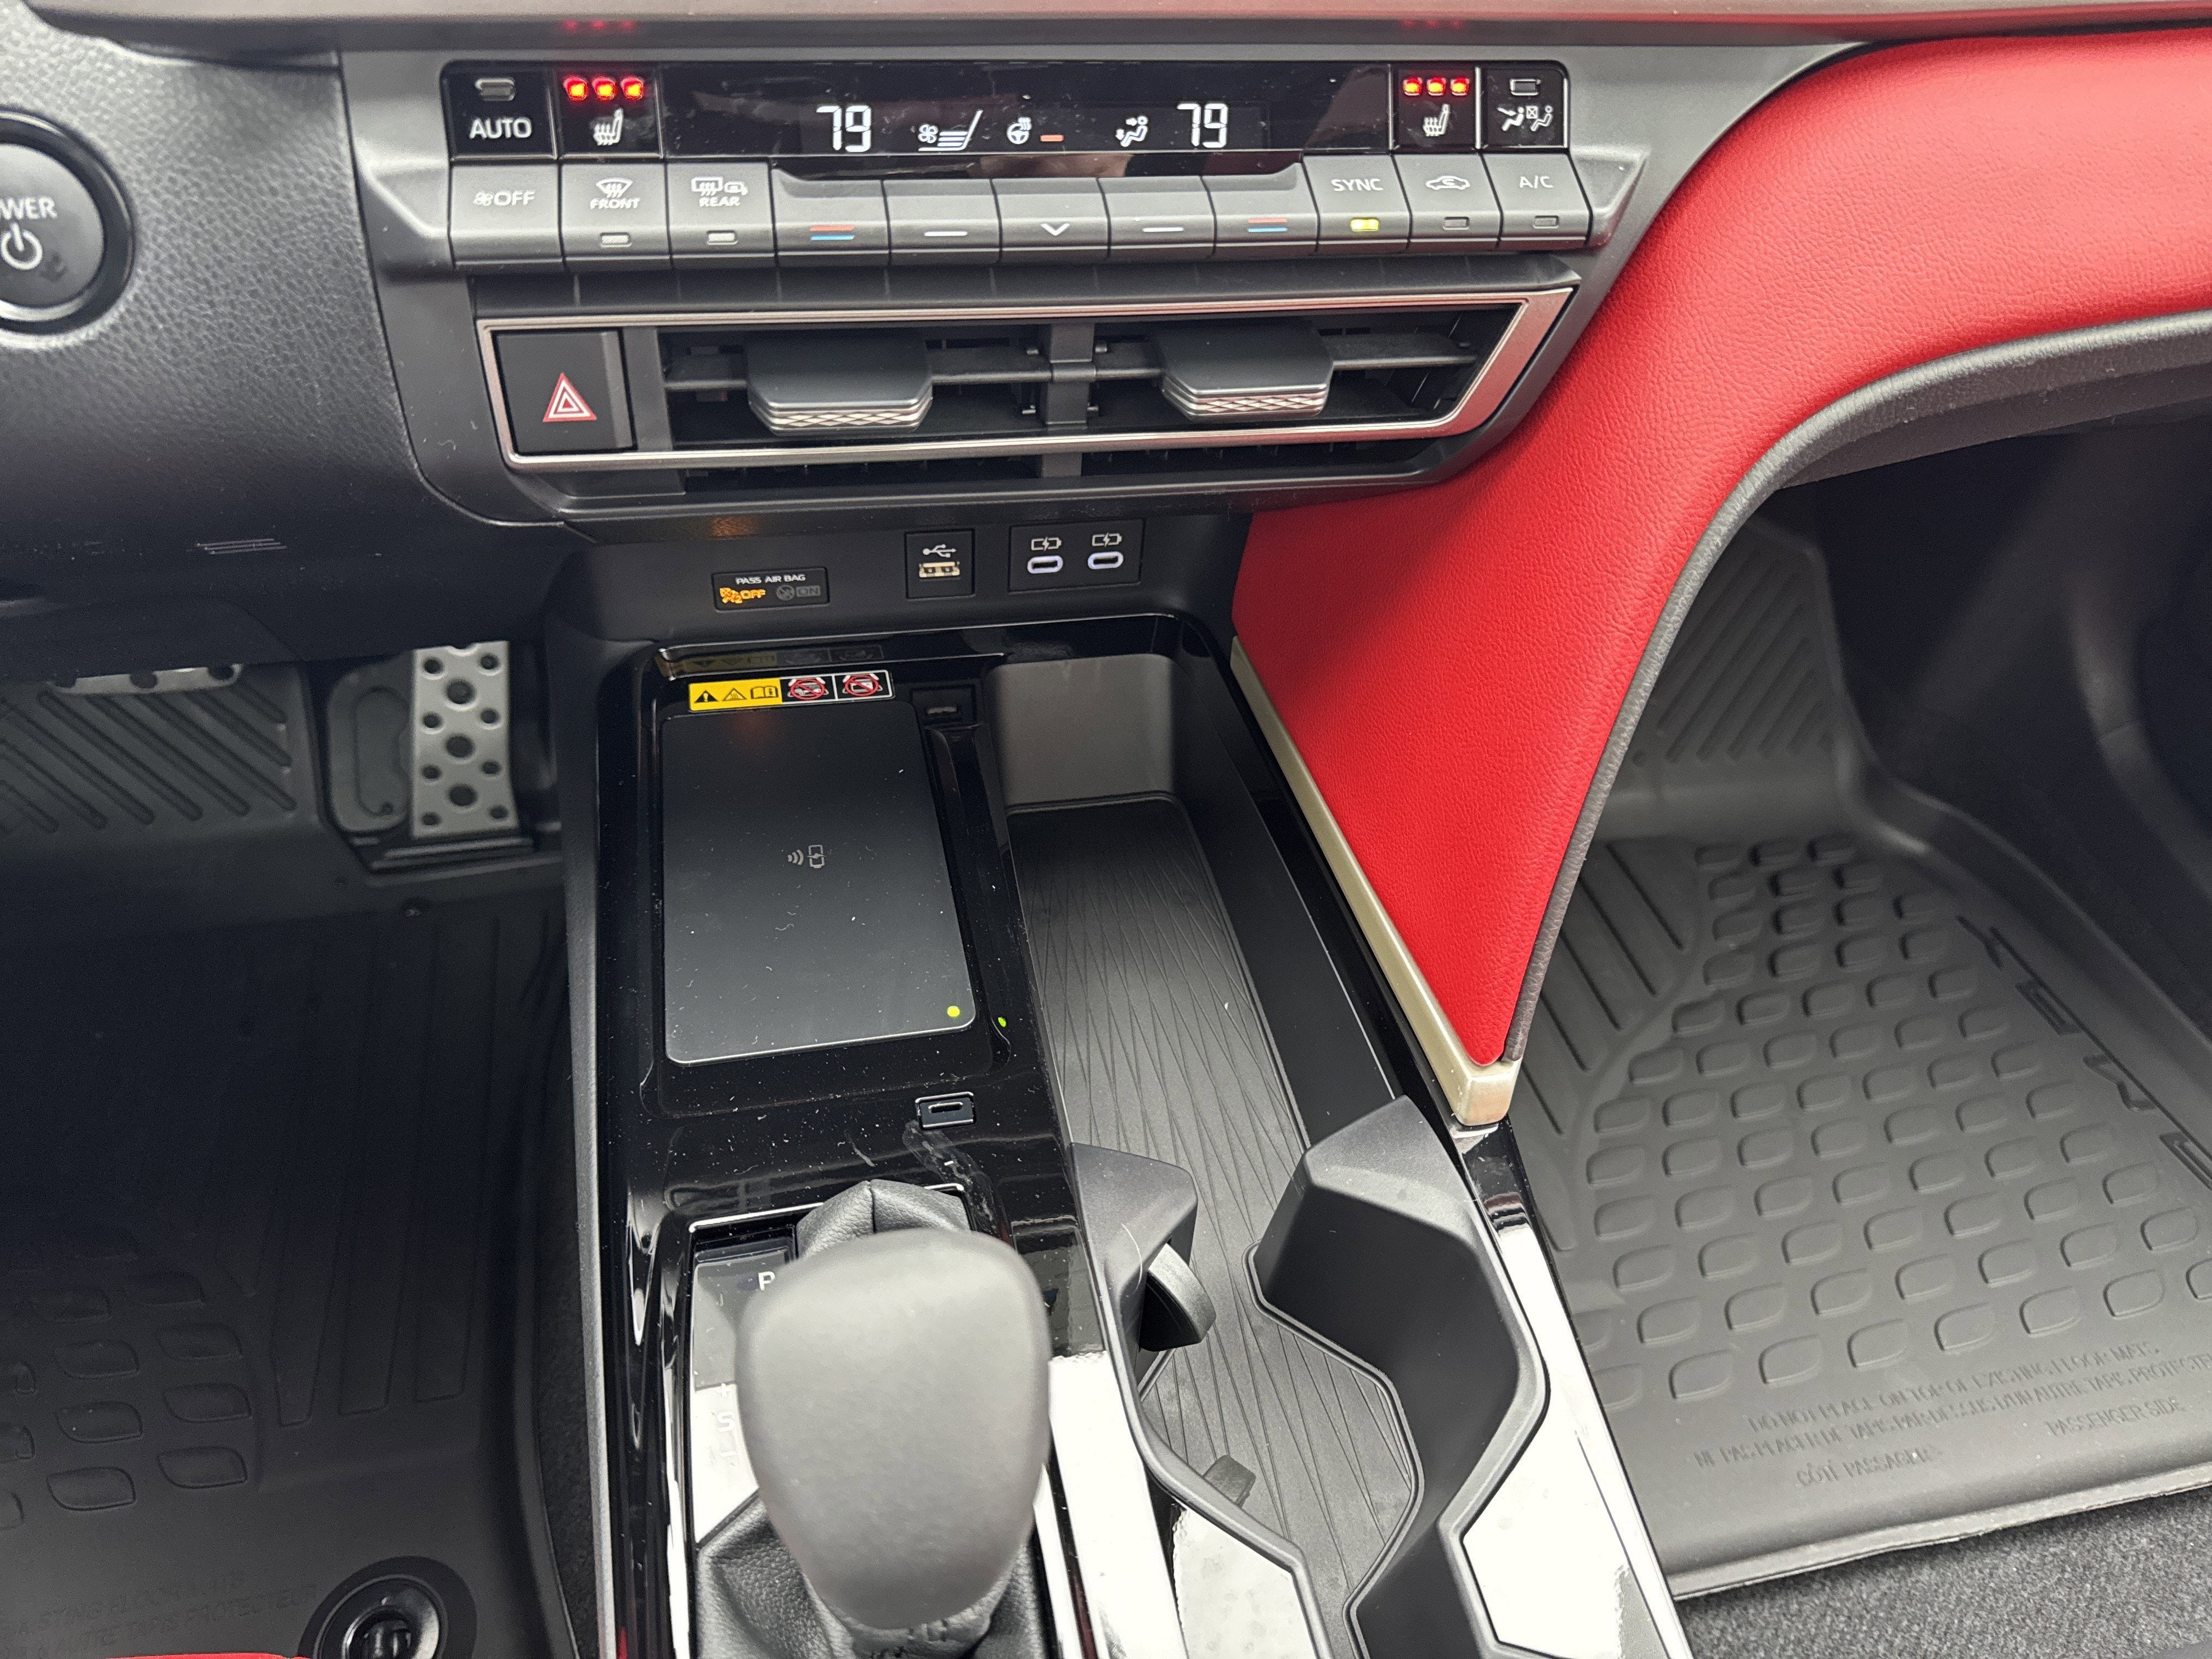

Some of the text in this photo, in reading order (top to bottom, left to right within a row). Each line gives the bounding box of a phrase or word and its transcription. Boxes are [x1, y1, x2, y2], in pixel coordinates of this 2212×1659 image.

[469, 117, 533, 139] AUTO
[817, 104, 872, 153] 79
[1177, 102, 1227, 148] 79
[1331, 178, 1383, 192] SYNC
[1520, 176, 1553, 189] A/C
[494, 191, 535, 206] OFF
[590, 196, 640, 210] FRONT
[699, 195, 741, 207] REAR
[0, 196, 58, 219] WER
[735, 573, 806, 585] PASS AIR BAG
[740, 589, 766, 599] OFF
[758, 1271, 775, 1291] P
[2044, 1395, 2187, 1437] PASSENGER SIDE
